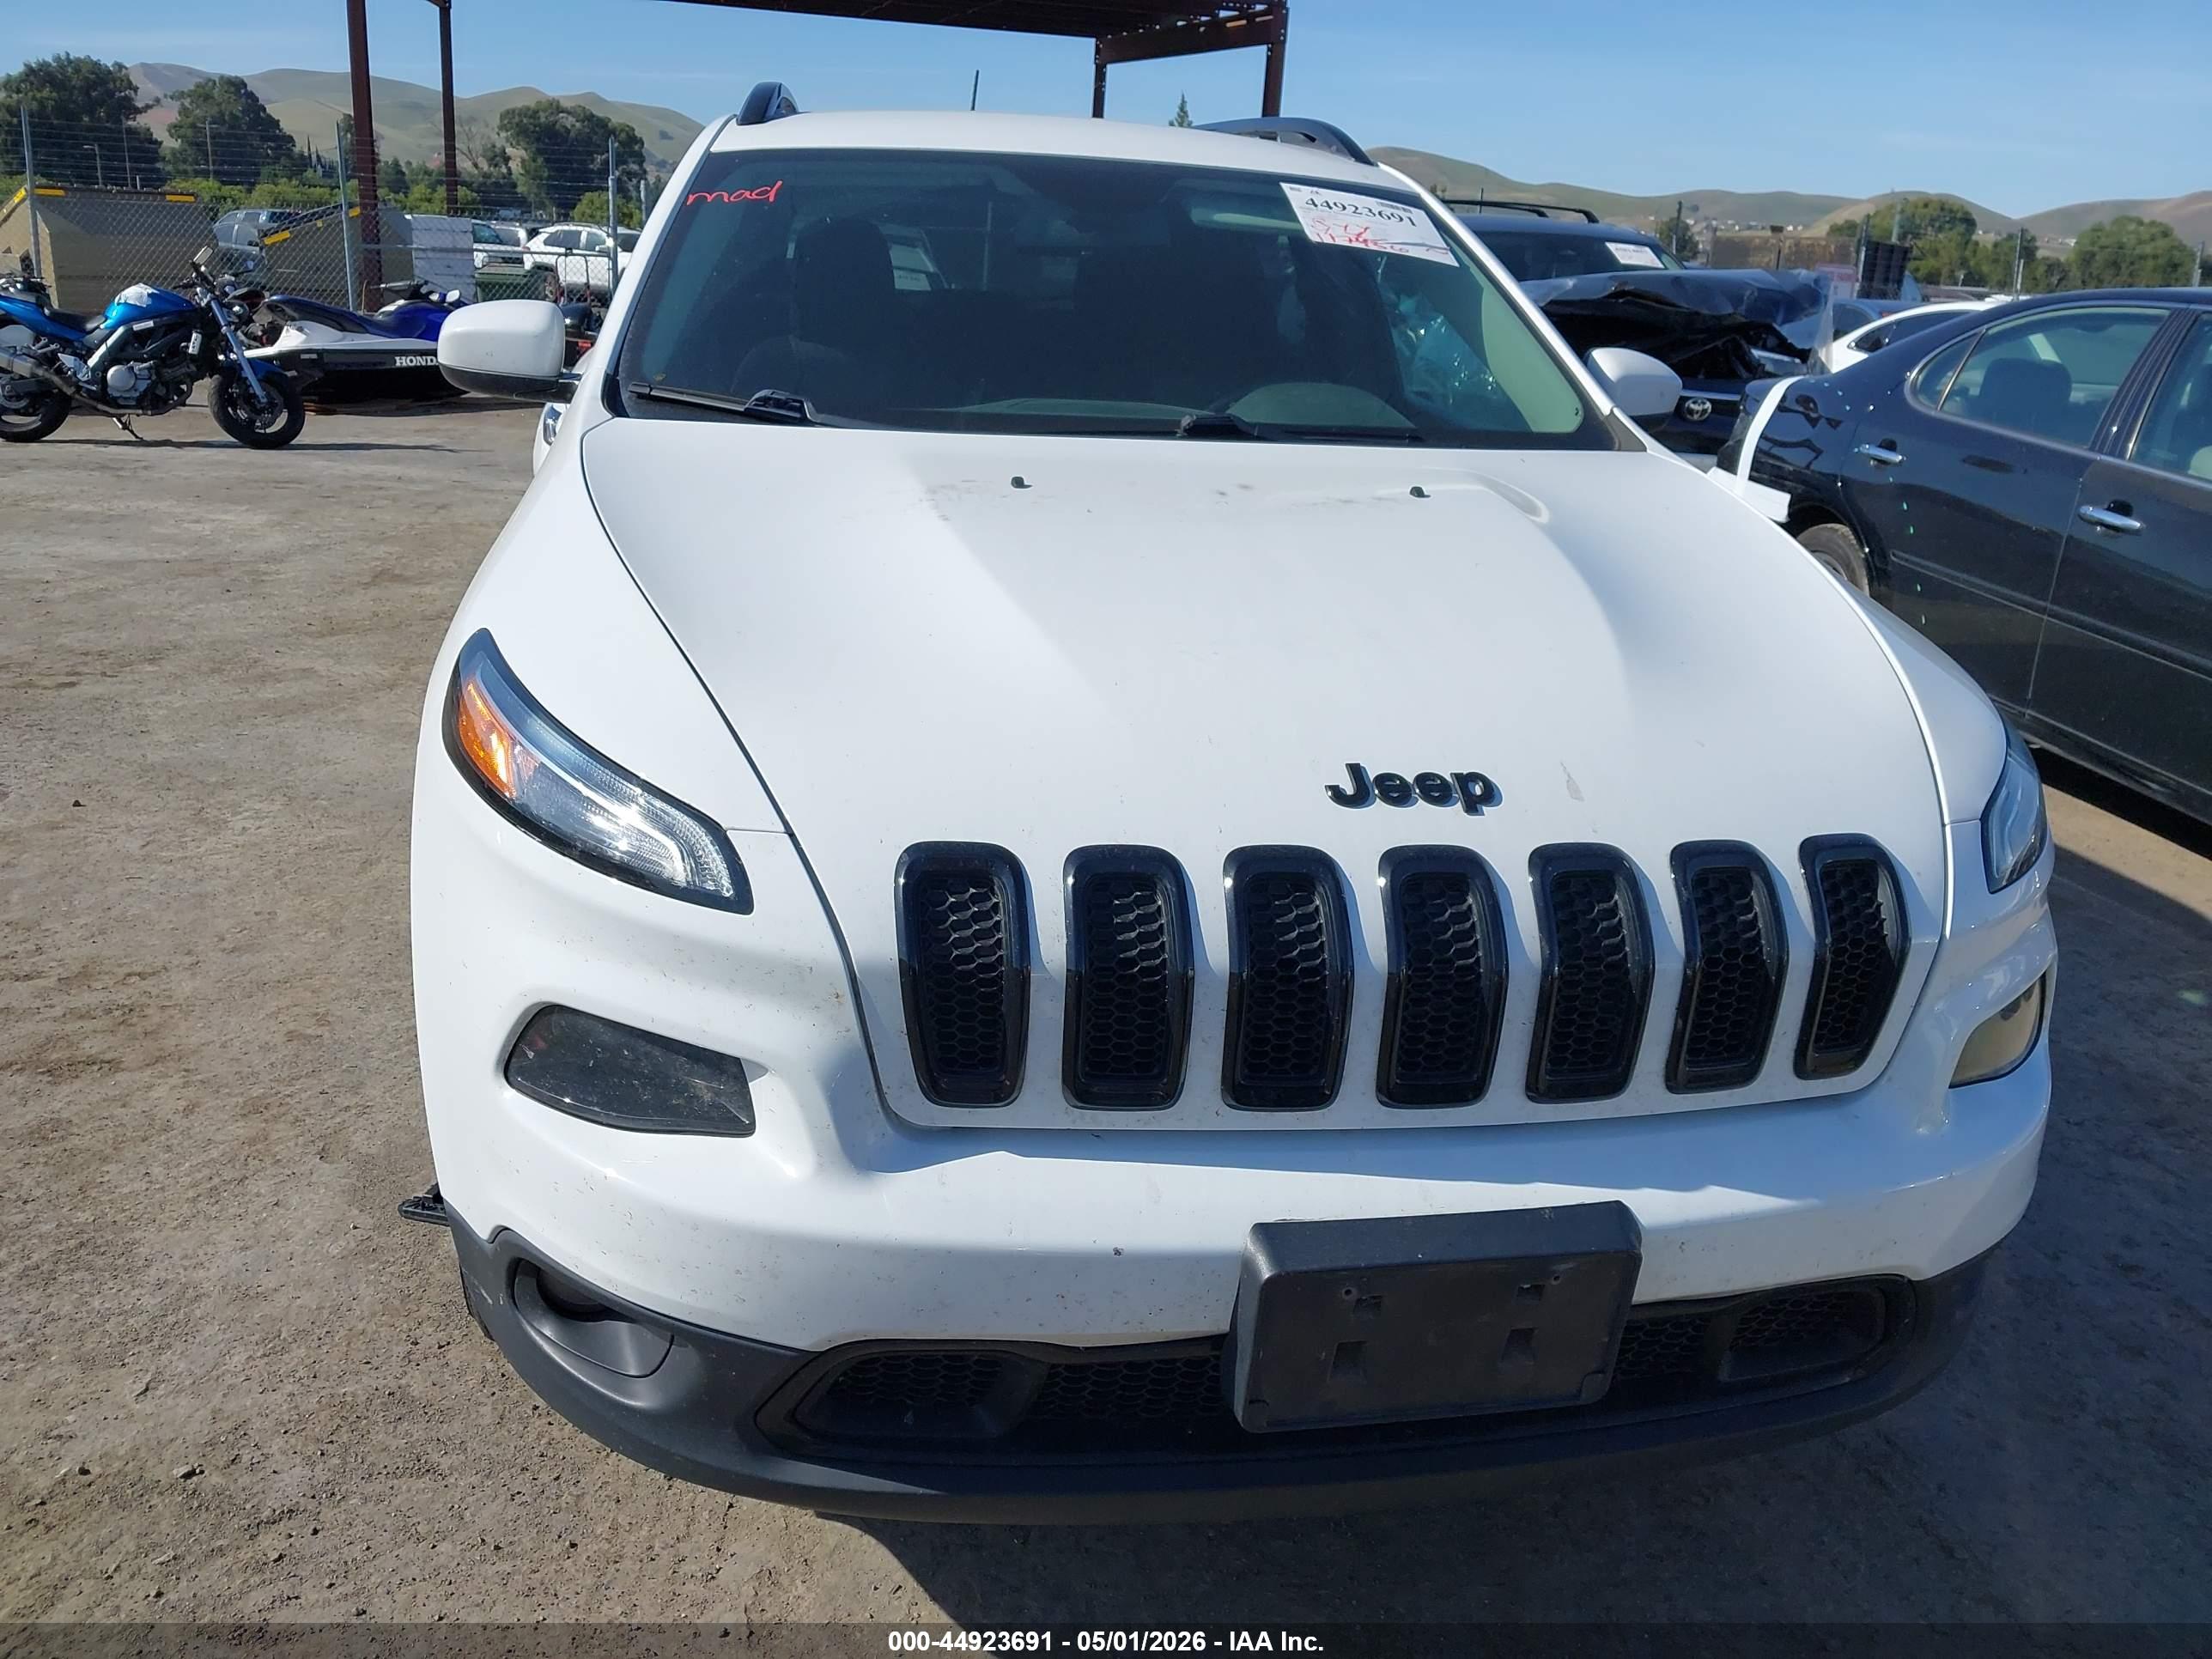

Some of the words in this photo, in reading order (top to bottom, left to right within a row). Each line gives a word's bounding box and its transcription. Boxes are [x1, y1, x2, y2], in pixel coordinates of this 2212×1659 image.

[686, 179, 783, 205] mad
[1305, 197, 1418, 228] 44923691
[394, 356, 439, 367] HOND
[1324, 763, 1499, 816] Jeep
